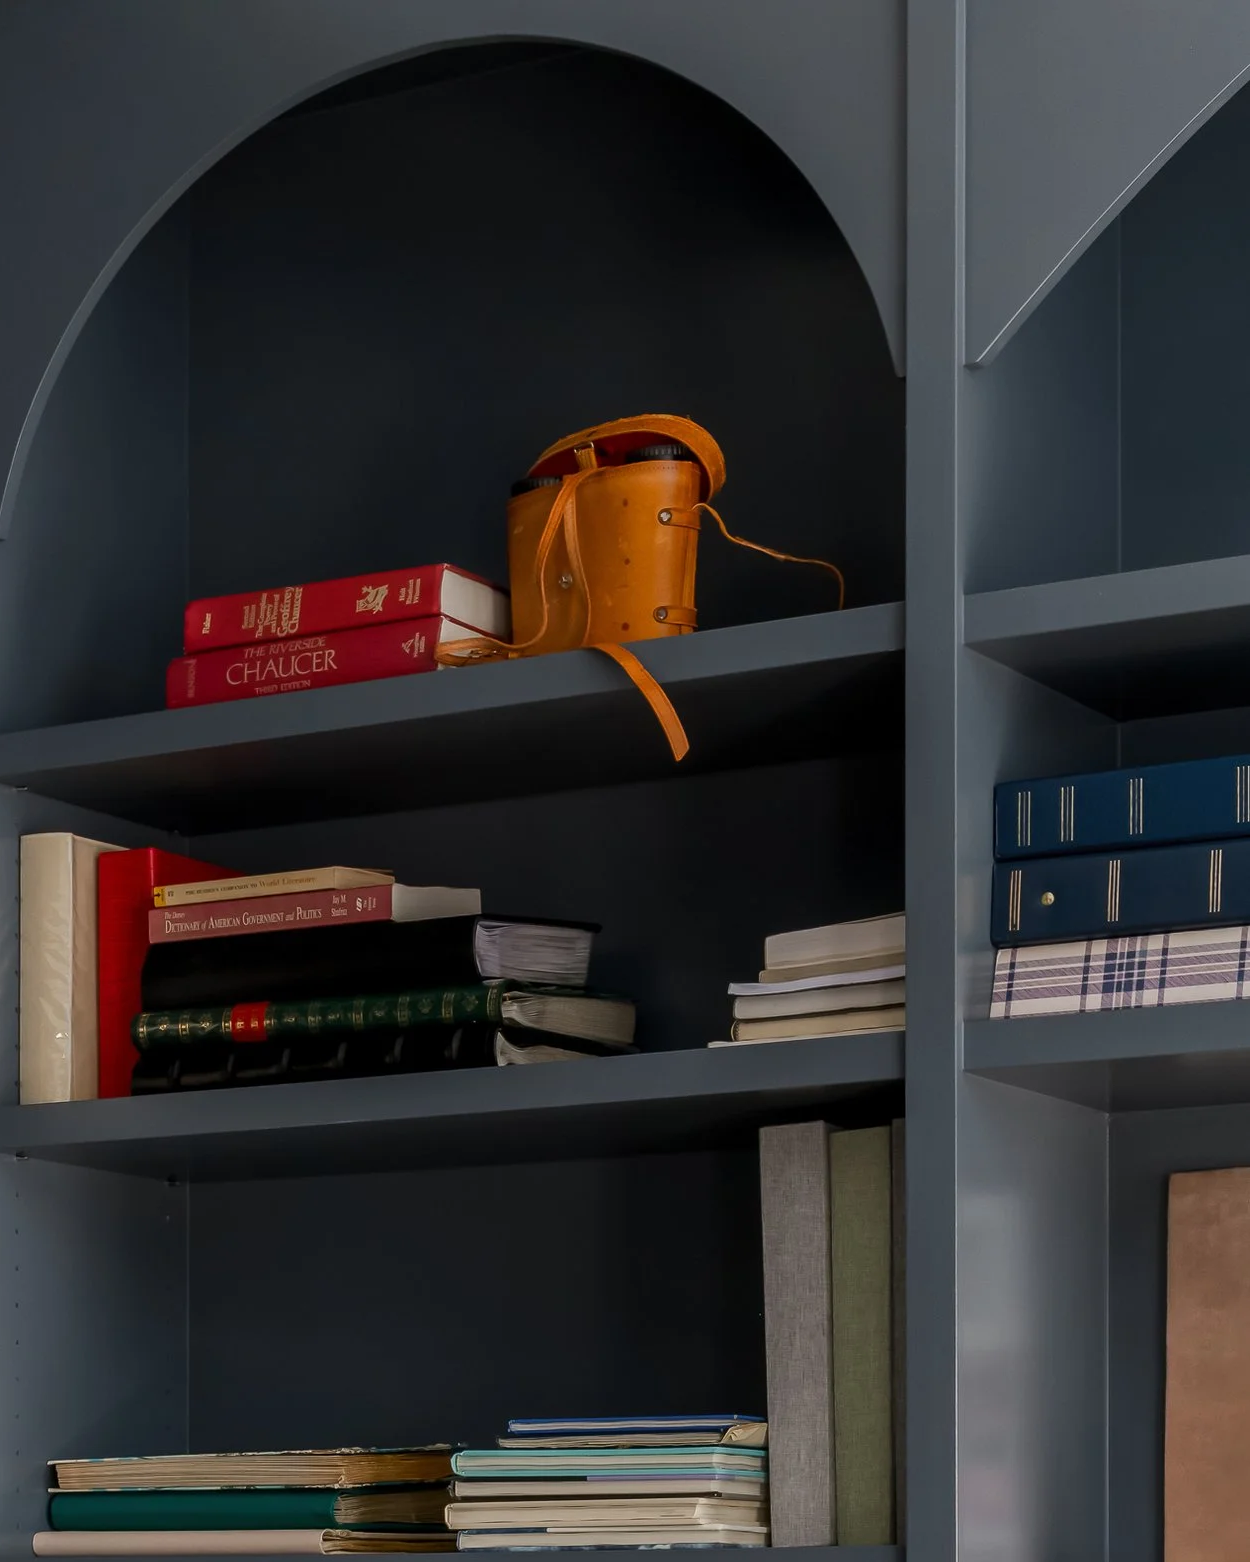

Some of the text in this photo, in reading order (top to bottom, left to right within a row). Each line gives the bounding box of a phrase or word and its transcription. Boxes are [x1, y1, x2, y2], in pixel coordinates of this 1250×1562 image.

[277, 586, 294, 637] Geoffrey
[288, 587, 303, 633] Chaucer
[244, 636, 327, 659] THE RIVERSIDE
[226, 650, 338, 685] CHAUCER
[280, 680, 311, 691] EDITION
[165, 920, 201, 934] DICTIONARY
[208, 916, 241, 929] AMERICAN
[242, 911, 284, 926] GOVERNMENT
[296, 907, 322, 920] POLITICS
